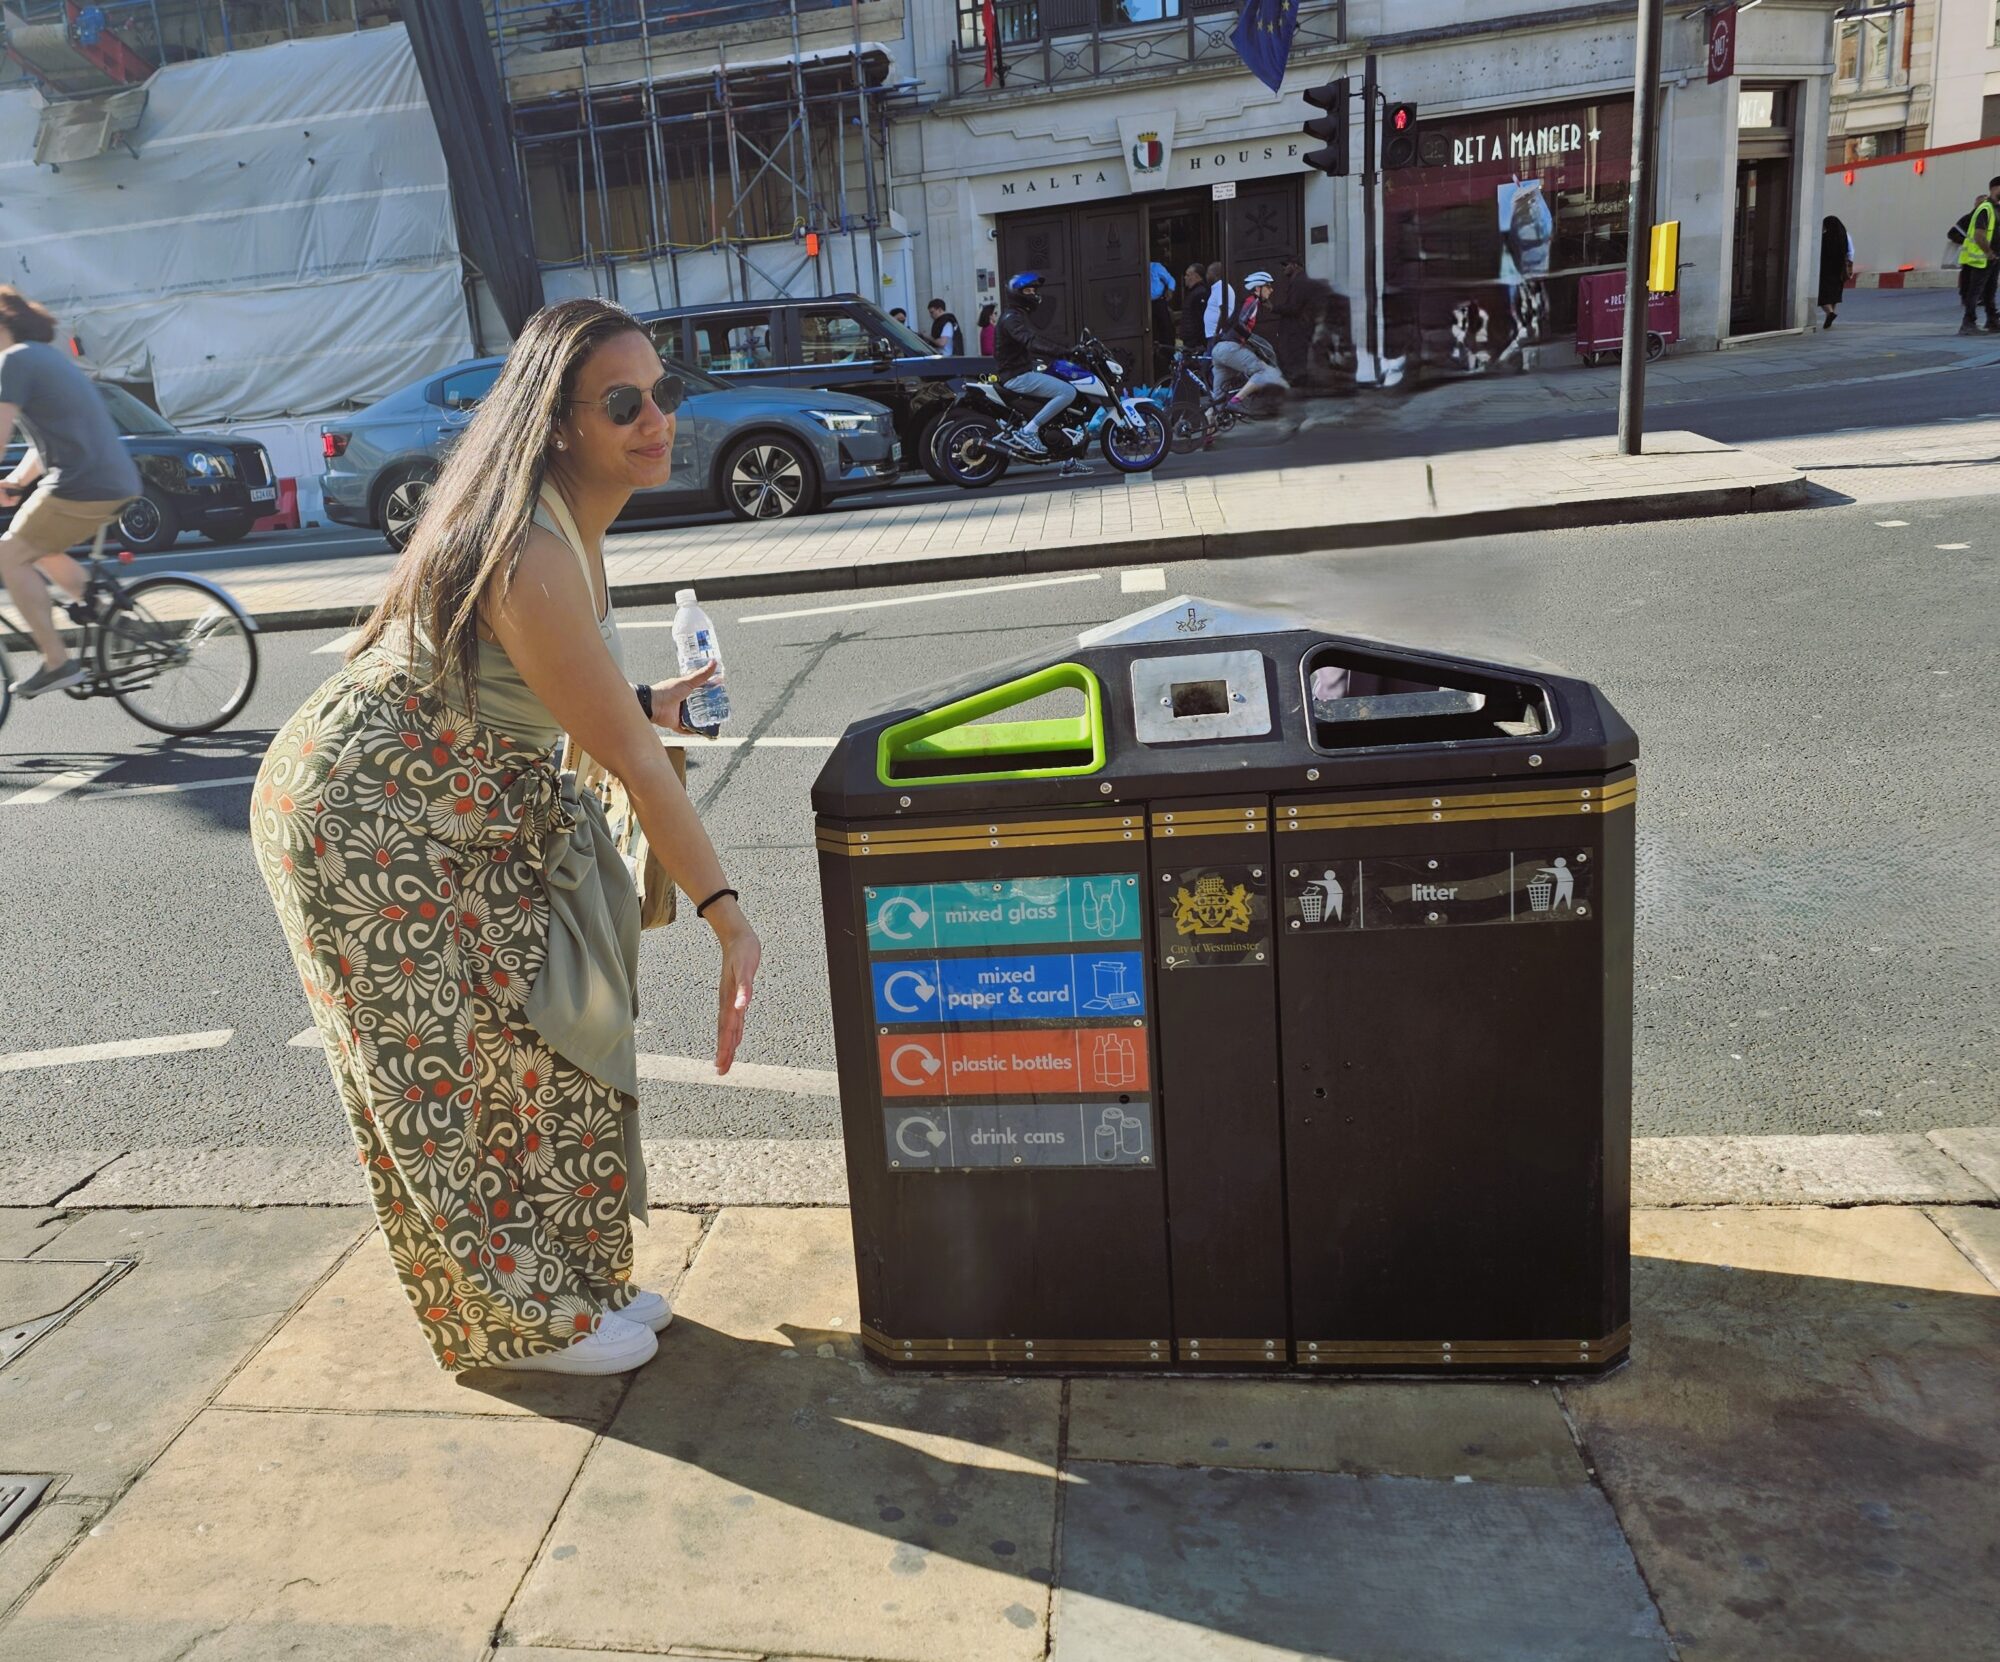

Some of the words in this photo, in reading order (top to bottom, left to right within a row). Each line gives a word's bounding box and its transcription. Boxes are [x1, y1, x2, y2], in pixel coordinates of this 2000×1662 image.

[1443, 135, 1486, 167] RET
[1491, 135, 1503, 161] A
[1510, 124, 1582, 158] MANGER
[1001, 170, 1107, 196] MALTA
[1189, 144, 1298, 171] HOUSE
[1411, 883, 1459, 902] litter
[945, 904, 1003, 924] mixed
[1008, 903, 1057, 926] glass
[1170, 943, 1189, 956] City
[1190, 943, 1201, 953] of
[1202, 941, 1260, 953] Westminster
[978, 964, 1036, 985] mixed
[948, 989, 1004, 1010] paper
[1008, 986, 1025, 1005] &
[1027, 984, 1069, 1003] card
[951, 1054, 1008, 1077] plastic
[1011, 1053, 1073, 1071] bottles
[970, 1126, 1018, 1145] drink
[1023, 1131, 1066, 1144] cans
